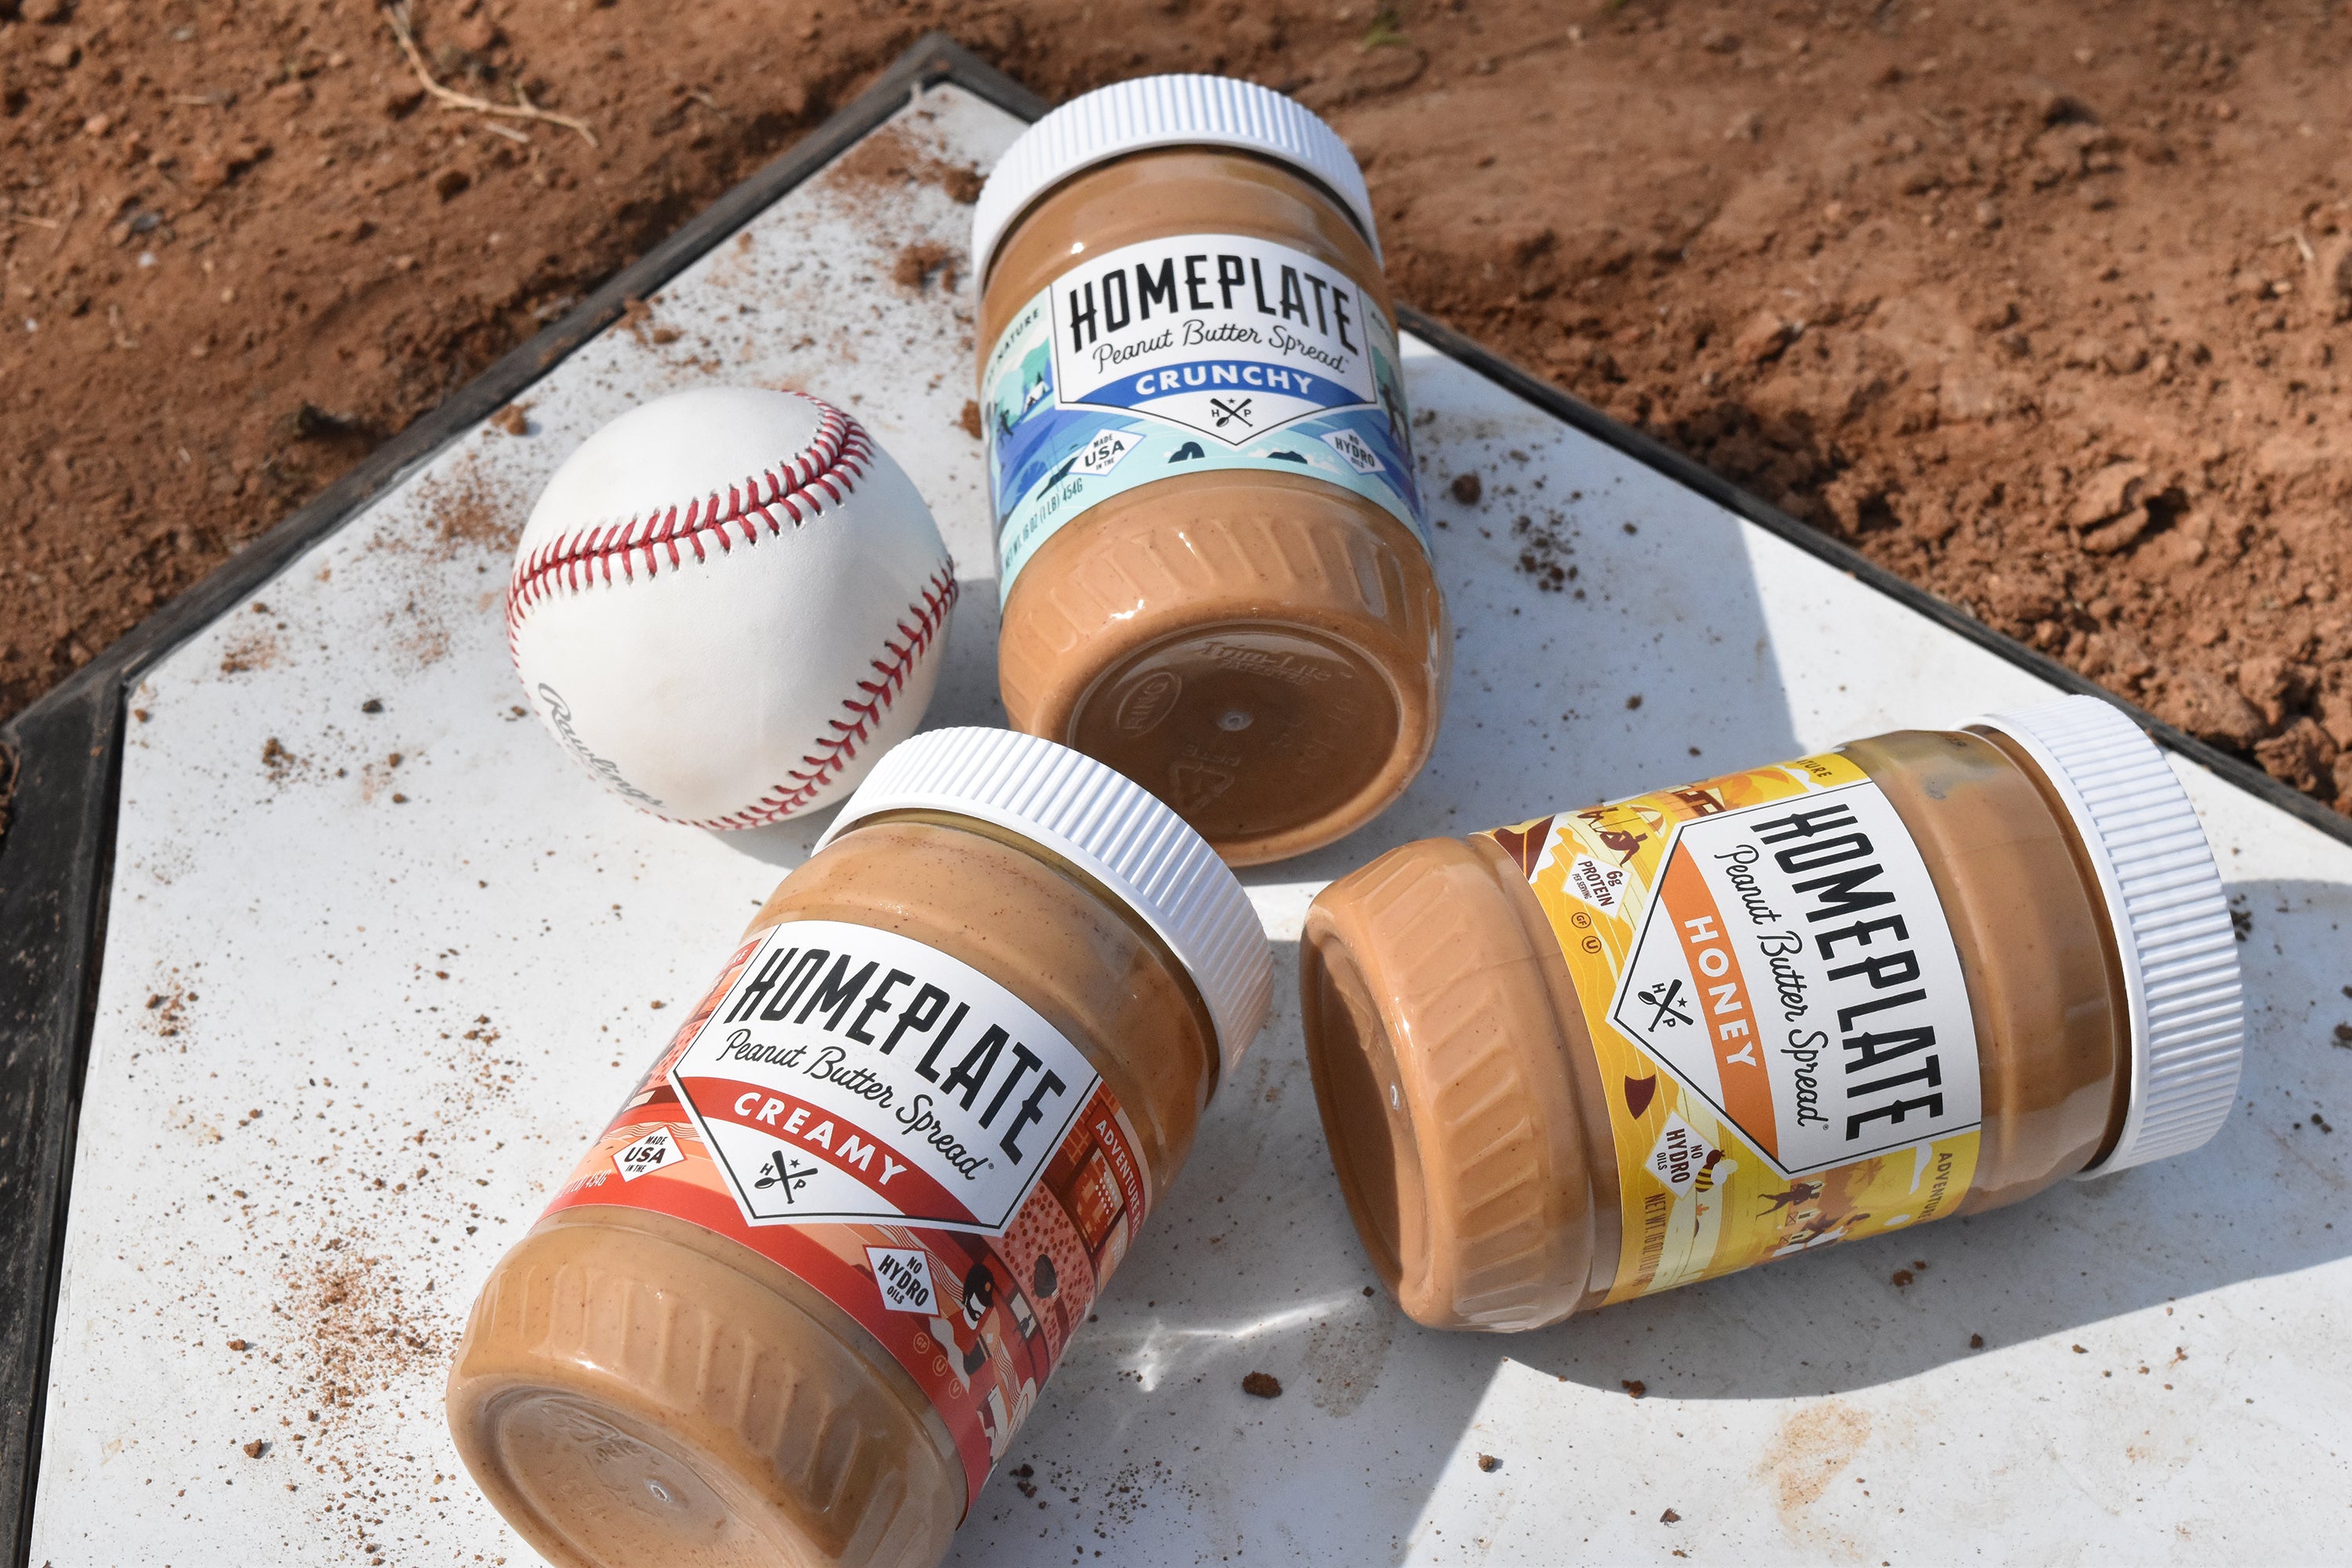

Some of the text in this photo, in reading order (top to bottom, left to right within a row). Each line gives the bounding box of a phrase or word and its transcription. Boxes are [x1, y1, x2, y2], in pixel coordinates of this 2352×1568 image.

[1069, 254, 1358, 354] HOMEPLATE
[1093, 329, 1173, 373] Peanut
[1182, 318, 1262, 347] Butter
[1135, 365, 1313, 396] CRUNCHY
[1211, 408, 1252, 417] H P
[1084, 440, 1125, 467] USA
[1094, 434, 1113, 448] MADE
[1334, 437, 1375, 467] HYDRO
[1104, 457, 1115, 466] THE
[1062, 477, 1083, 502] 454G
[538, 683, 666, 808] Rawlings
[1572, 873, 1592, 899] PER SERVING
[1577, 860, 1615, 906] PROTEIN
[1606, 870, 1624, 887] 6g
[1576, 915, 1588, 926] GF
[1714, 844, 1782, 925] Peanut
[1756, 931, 1809, 1022] Butter
[1750, 804, 1944, 1141] HOMEPLATE
[1684, 915, 1757, 1066] HONEY
[1651, 982, 1676, 1028] H P
[716, 1028, 808, 1069] Peanut
[803, 1046, 894, 1109] Butter
[723, 947, 1066, 1166] HOMEPLATE
[644, 1136, 668, 1145] MADE
[734, 1091, 908, 1185] CREAMY
[623, 1147, 666, 1164] USA
[1656, 1152, 1668, 1171] OILS
[1666, 1128, 1690, 1183] HYDRO
[1690, 1144, 1703, 1159] NO
[633, 1164, 647, 1173] THE
[760, 1163, 807, 1190] H P
[1095, 1120, 1141, 1214] ADVENTURE
[1644, 1192, 1666, 1214] NET
[1644, 1214, 1666, 1233] WT.
[1642, 1242, 1664, 1255] OZ
[1644, 1232, 1664, 1243] 16
[906, 1256, 923, 1275] NO
[877, 1254, 929, 1307] HYDRO
[886, 1286, 906, 1305] OILS
[917, 1336, 927, 1349] GF
